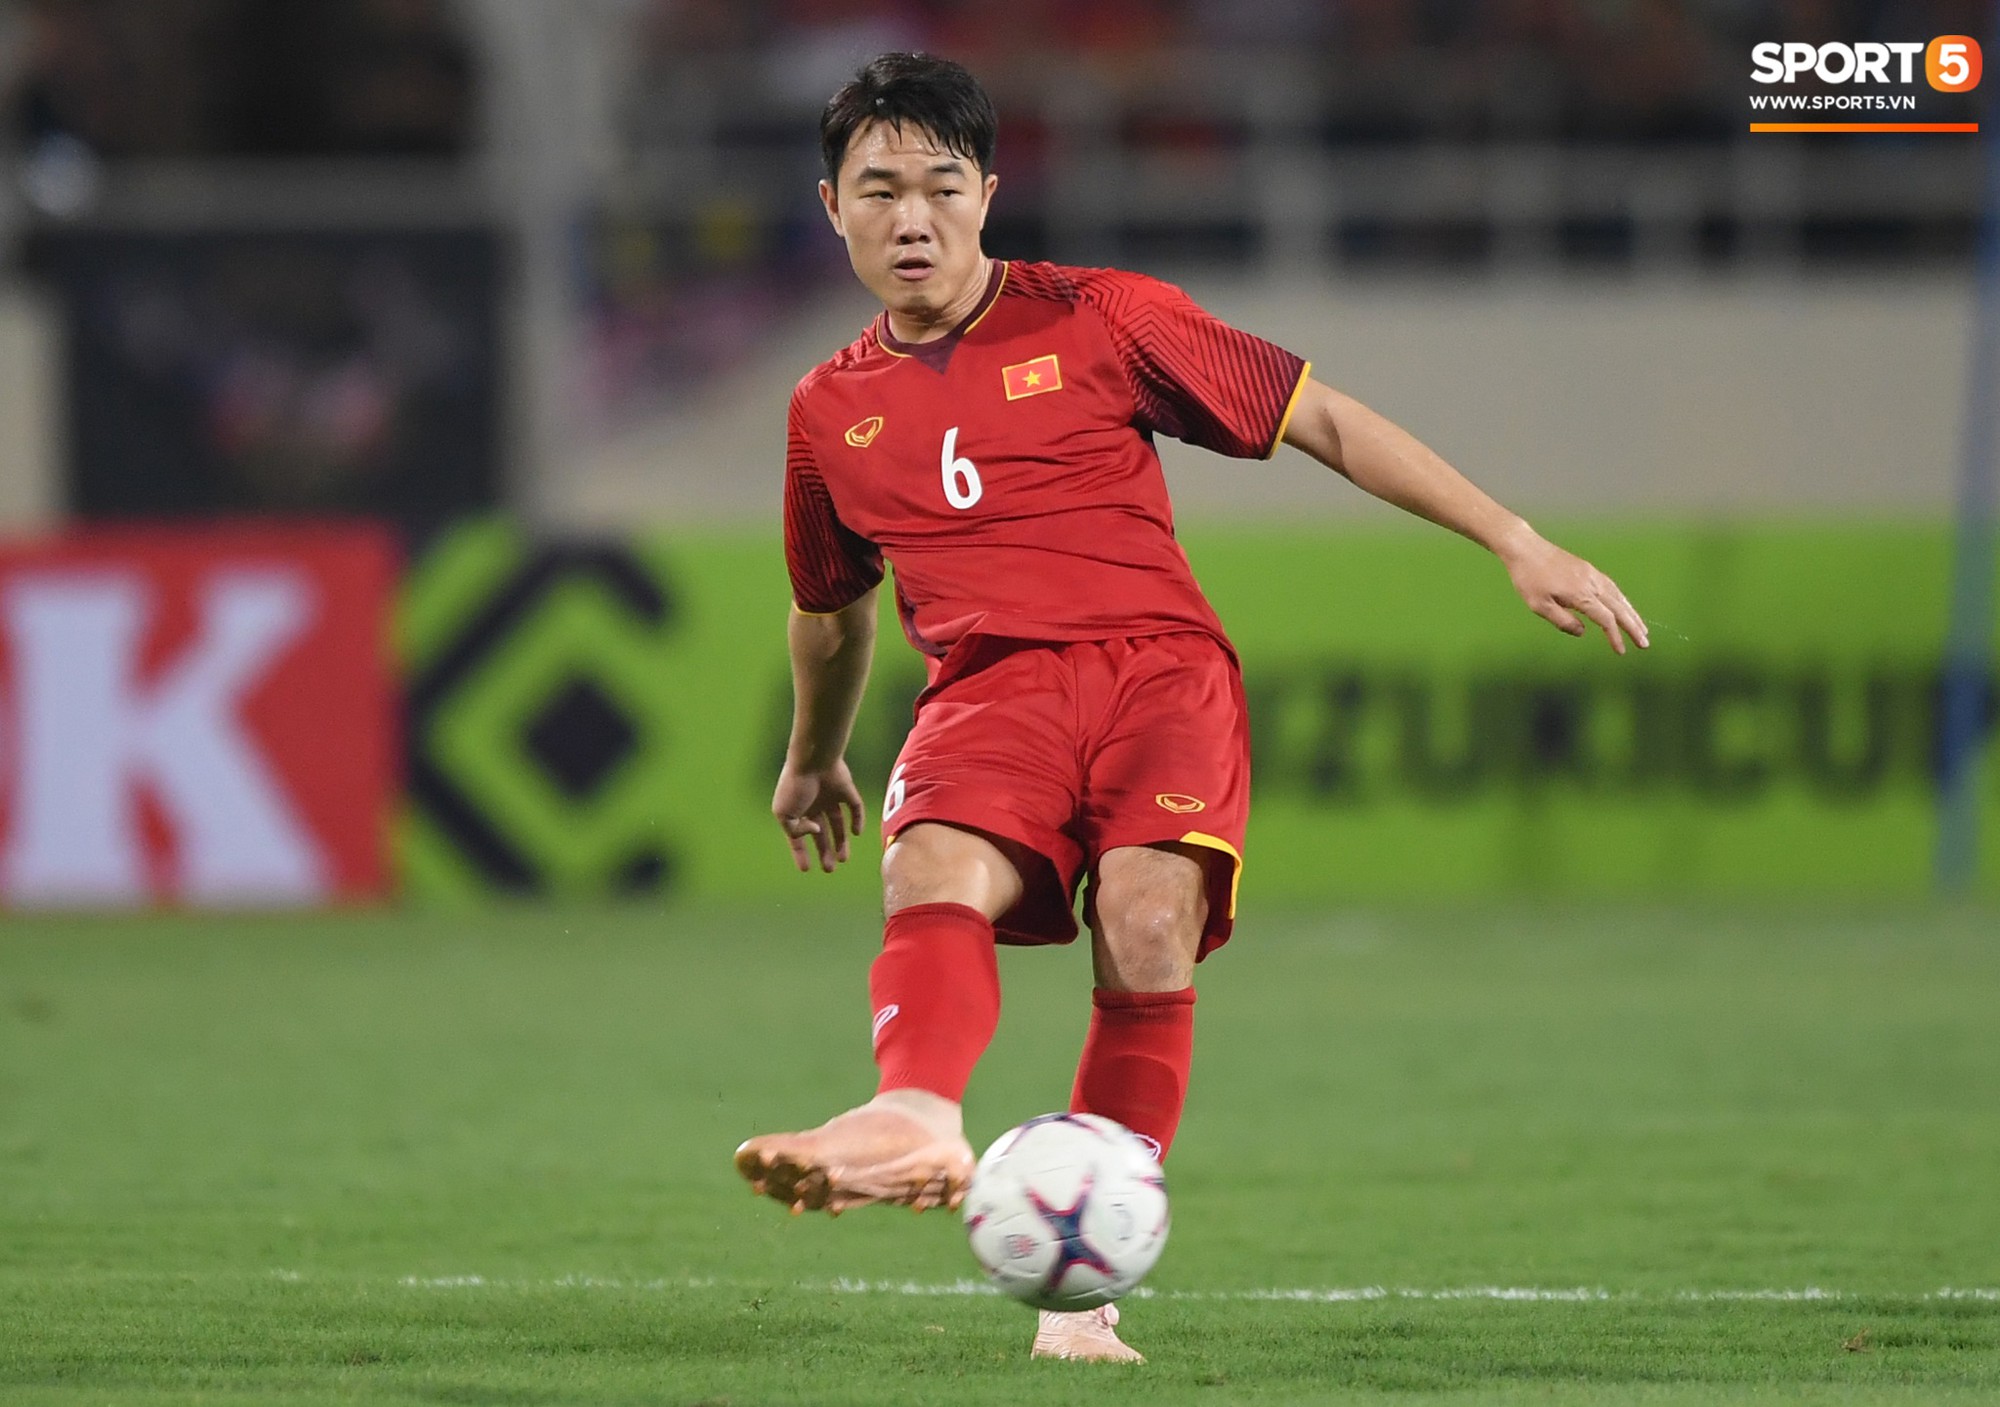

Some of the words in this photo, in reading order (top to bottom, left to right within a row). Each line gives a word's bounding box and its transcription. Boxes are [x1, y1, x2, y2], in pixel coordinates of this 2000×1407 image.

[941, 426, 983, 509] 6
[3, 562, 332, 908] K
[882, 762, 905, 822] 6
